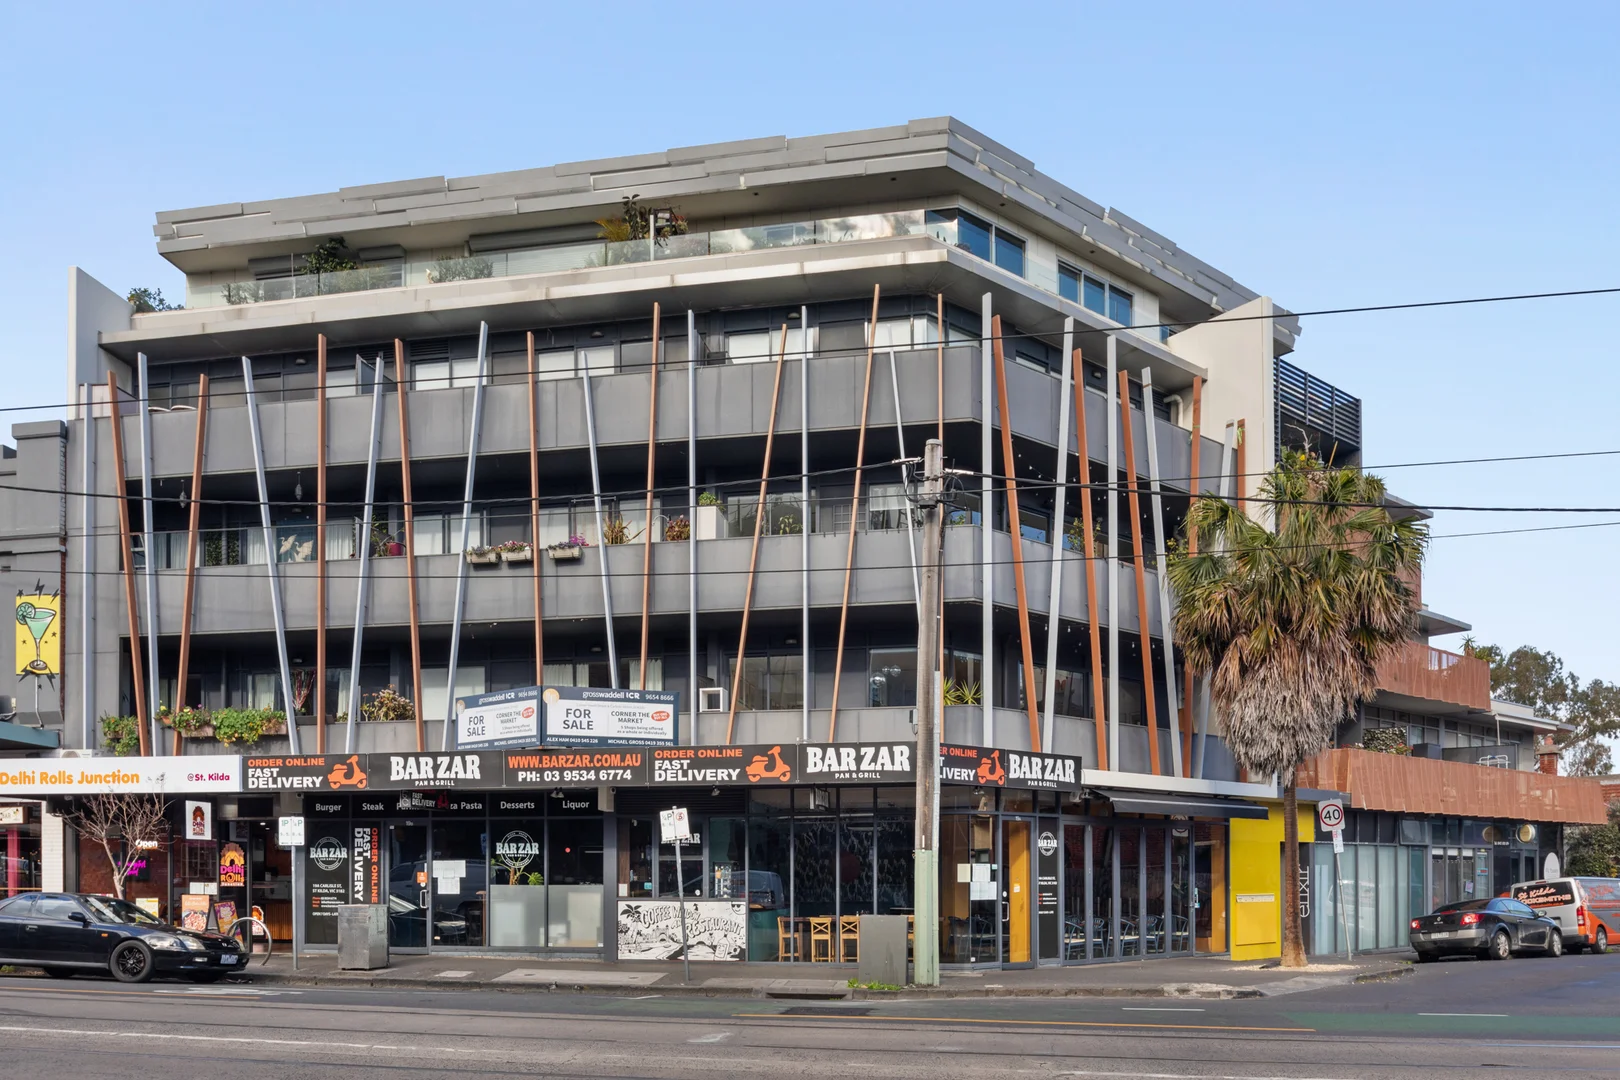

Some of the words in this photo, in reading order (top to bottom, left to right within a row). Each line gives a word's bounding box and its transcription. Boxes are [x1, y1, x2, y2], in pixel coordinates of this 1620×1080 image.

[566, 708, 591, 718] FOR
[468, 716, 484, 726] FOR
[563, 719, 594, 730] SALE
[467, 726, 486, 737] SALE
[654, 750, 695, 758] ORDER
[698, 749, 743, 758] ONLINE
[806, 746, 856, 773] BAR
[860, 745, 910, 772] ZAR
[950, 749, 978, 758] ONLINE
[248, 758, 283, 767] ORDER
[285, 758, 325, 766] ONLINE
[508, 754, 641, 768] WWW.BARZAR.COM.AU
[655, 760, 690, 770] FAST
[248, 768, 279, 778] FAST
[390, 756, 434, 781] BAR
[436, 755, 480, 779] ZAR
[1009, 753, 1043, 779] BAR
[1044, 758, 1075, 783] ZAR
[0, 770, 35, 785] Delhi
[40, 770, 73, 784] Rolls
[78, 769, 139, 784] Junction
[208, 773, 230, 781] Kilda
[518, 771, 540, 782] PH:
[544, 771, 560, 781] 03
[564, 770, 596, 781] 9534
[600, 770, 632, 780] 6774
[655, 769, 741, 781] DELIVERY
[248, 776, 323, 788] DELIVERY
[412, 798, 436, 807] DELIVERY
[563, 800, 589, 810] Liquor
[315, 804, 342, 813] Burger
[1324, 809, 1340, 821] 40
[135, 839, 157, 849] Open
[496, 842, 517, 854] BAR
[518, 842, 539, 854] ZAR
[310, 848, 328, 858] BAR
[329, 848, 348, 858] ZAR
[220, 864, 244, 876] Delhi
[354, 828, 363, 901] DELIVERY
[220, 872, 244, 883] Rolls
[1299, 864, 1310, 918] elixir
[1530, 886, 1556, 898] Kilda
[641, 906, 671, 929] COFFEE
[686, 917, 744, 939] RESTAURANT
